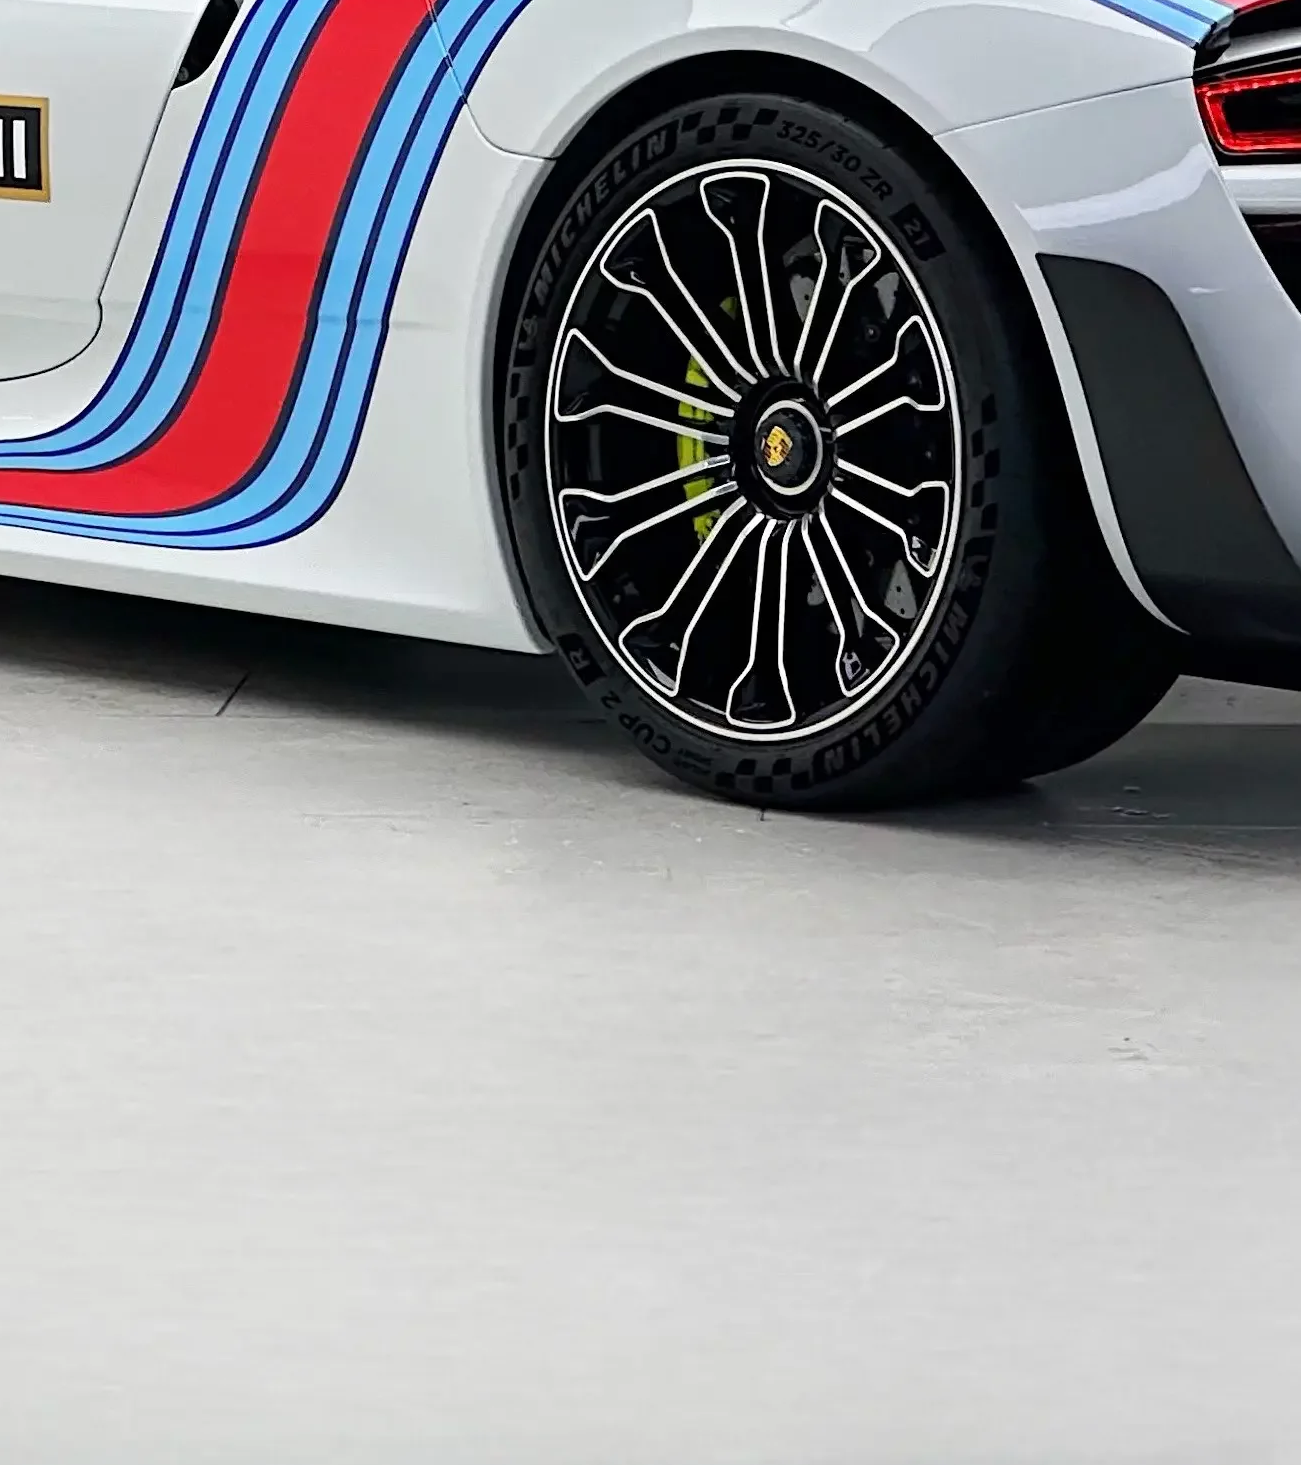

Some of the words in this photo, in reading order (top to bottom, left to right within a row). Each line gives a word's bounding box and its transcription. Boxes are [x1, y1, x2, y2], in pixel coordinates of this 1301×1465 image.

[534, 130, 667, 307] MICHELIN
[776, 120, 862, 173] 325/30
[858, 167, 893, 201] ZR
[902, 218, 930, 246] 21
[569, 648, 591, 671] R
[601, 690, 623, 710] 2
[825, 600, 969, 776] MICHELIN
[618, 712, 672, 755] CUP
